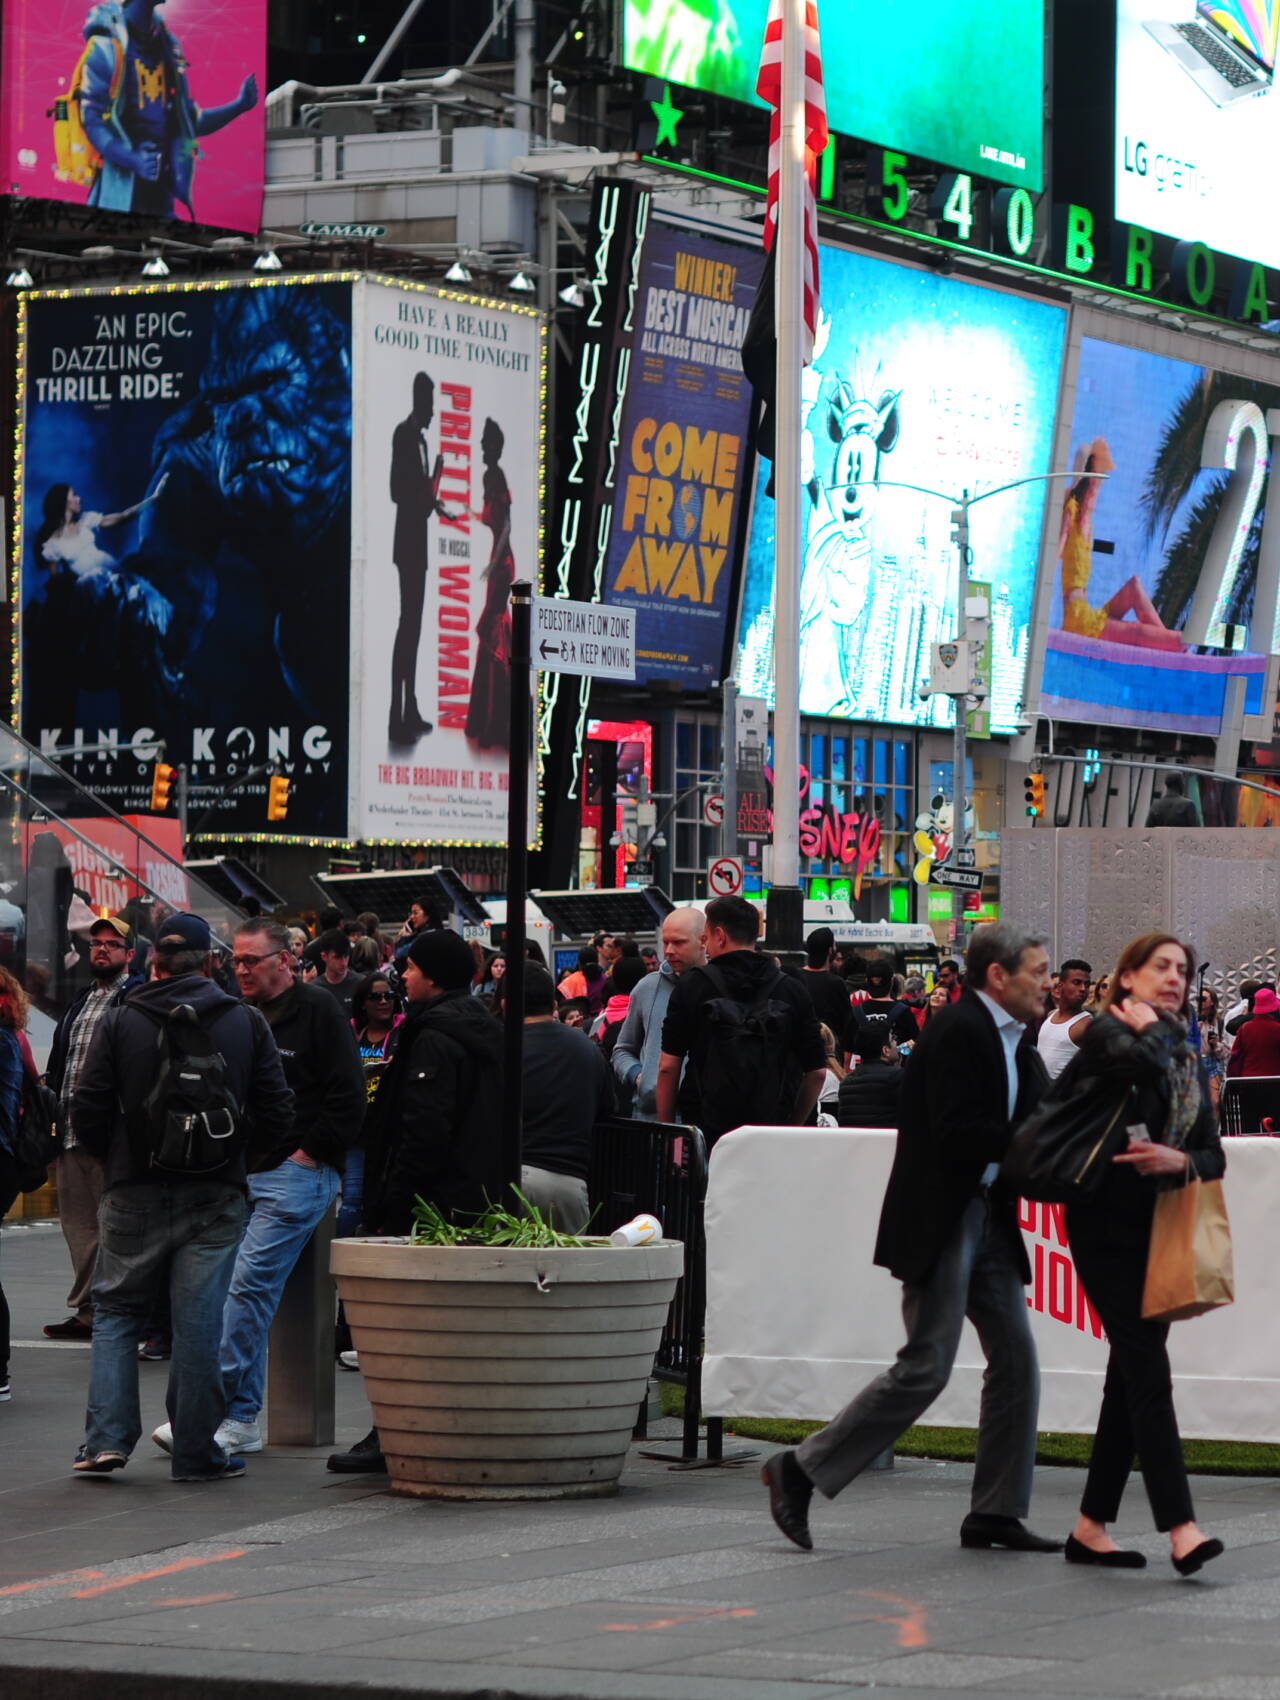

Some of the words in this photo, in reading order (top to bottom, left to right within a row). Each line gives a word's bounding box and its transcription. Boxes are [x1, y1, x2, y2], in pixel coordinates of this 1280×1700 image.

[1125, 136, 1147, 176] LG
[306, 223, 379, 238] LAMAR
[675, 252, 738, 303] WINNER!
[135, 311, 193, 338] EPIC,
[398, 302, 437, 329] HAVE
[445, 313, 452, 331] A
[457, 313, 510, 342] REALLY
[645, 286, 686, 335] BEST
[686, 296, 751, 350] MUSICA
[52, 343, 163, 373] DAZZLING
[374, 324, 420, 350] GOOD
[425, 333, 461, 360] TIME
[466, 341, 532, 372] TONIGHT
[35, 376, 112, 403] THRILL
[439, 382, 472, 536] PRETTY
[631, 417, 741, 489] COME
[622, 474, 735, 547] FROM
[613, 534, 728, 604] AWAY
[538, 608, 587, 635] PEDESTRIAN
[588, 615, 608, 636] FLOW
[610, 617, 630, 639] ZONE
[437, 564, 471, 730] WOMAN
[580, 641, 599, 665] KEEP
[601, 644, 630, 668] MOVING
[40, 728, 160, 761] KING
[192, 726, 332, 762] KONG
[937, 871, 953, 882] ONE
[959, 873, 976, 885] WAY
